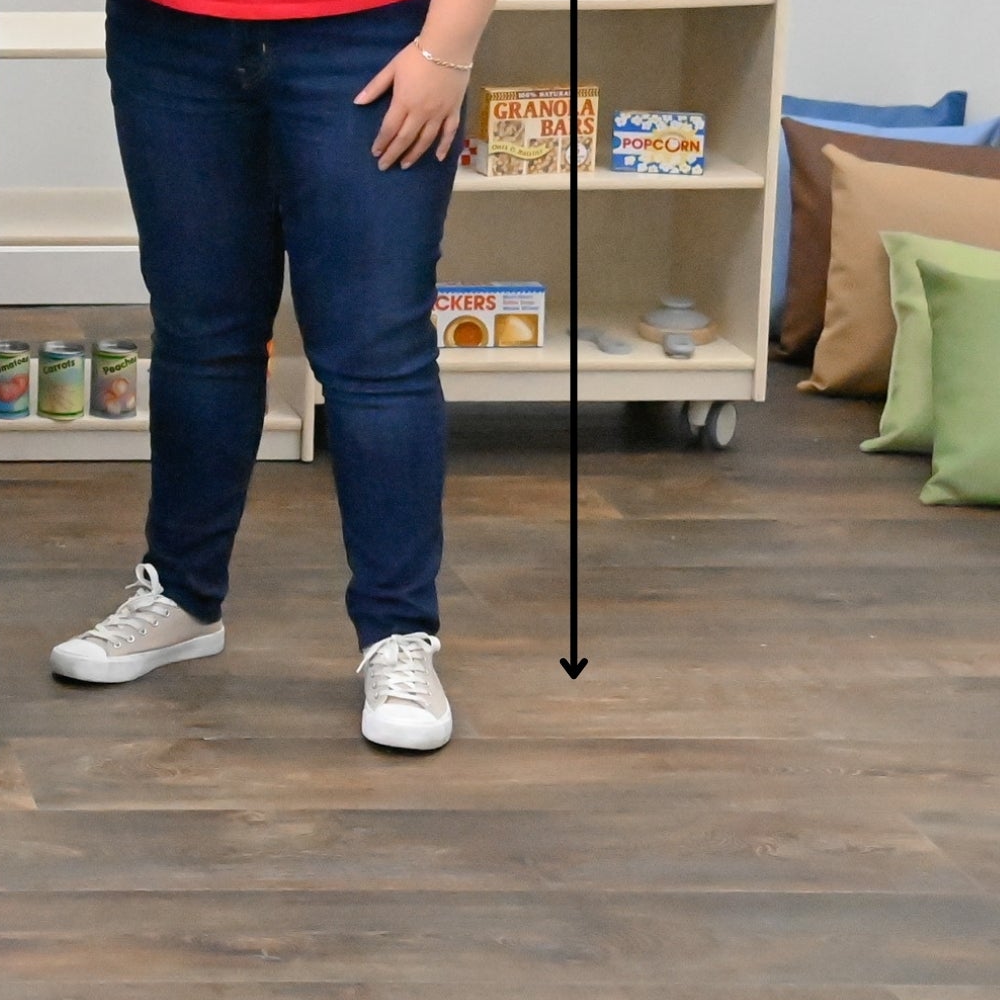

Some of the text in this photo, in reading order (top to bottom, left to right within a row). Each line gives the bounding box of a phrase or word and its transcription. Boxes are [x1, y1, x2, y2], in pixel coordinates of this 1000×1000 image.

[622, 137, 700, 153] POPCORN
[434, 295, 496, 311] CKERS
[42, 358, 76, 375] Carrots
